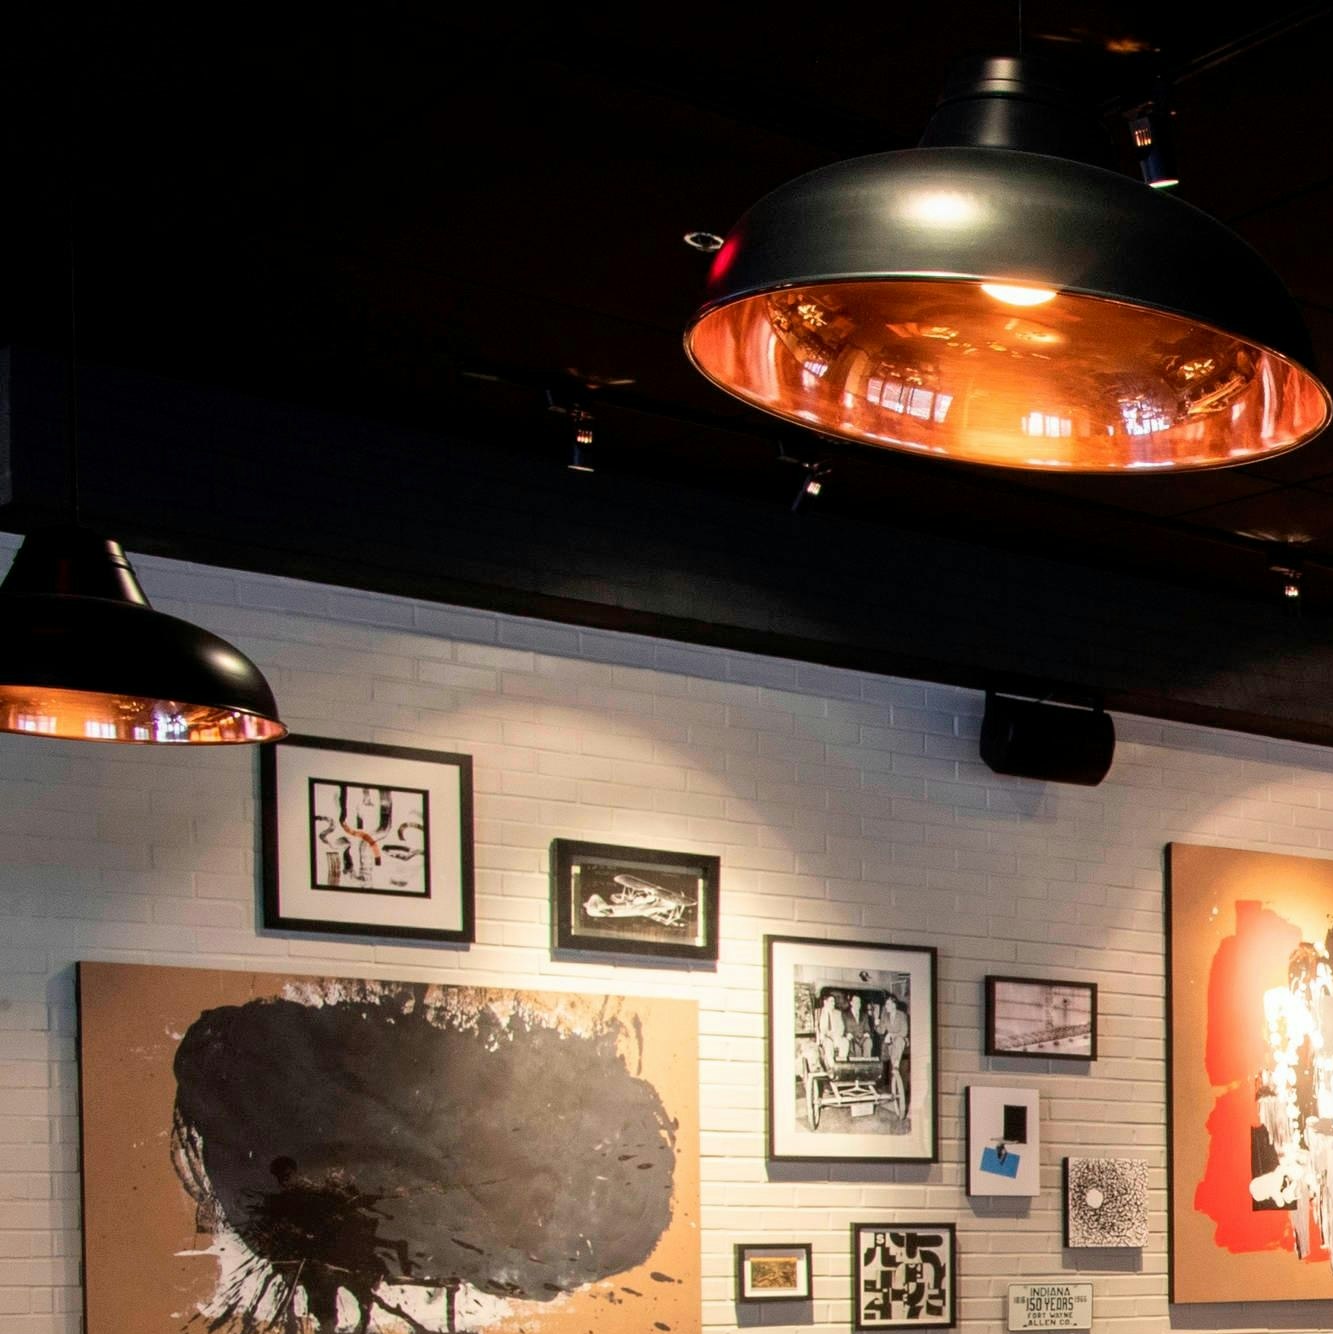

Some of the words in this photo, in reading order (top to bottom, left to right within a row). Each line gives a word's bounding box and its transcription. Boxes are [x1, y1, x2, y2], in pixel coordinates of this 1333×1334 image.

[1030, 1287, 1071, 1297] INDIANA
[1026, 1297, 1042, 1312] 150
[1044, 1297, 1074, 1311] YEARS
[1028, 1319, 1056, 1327] ALLEN
